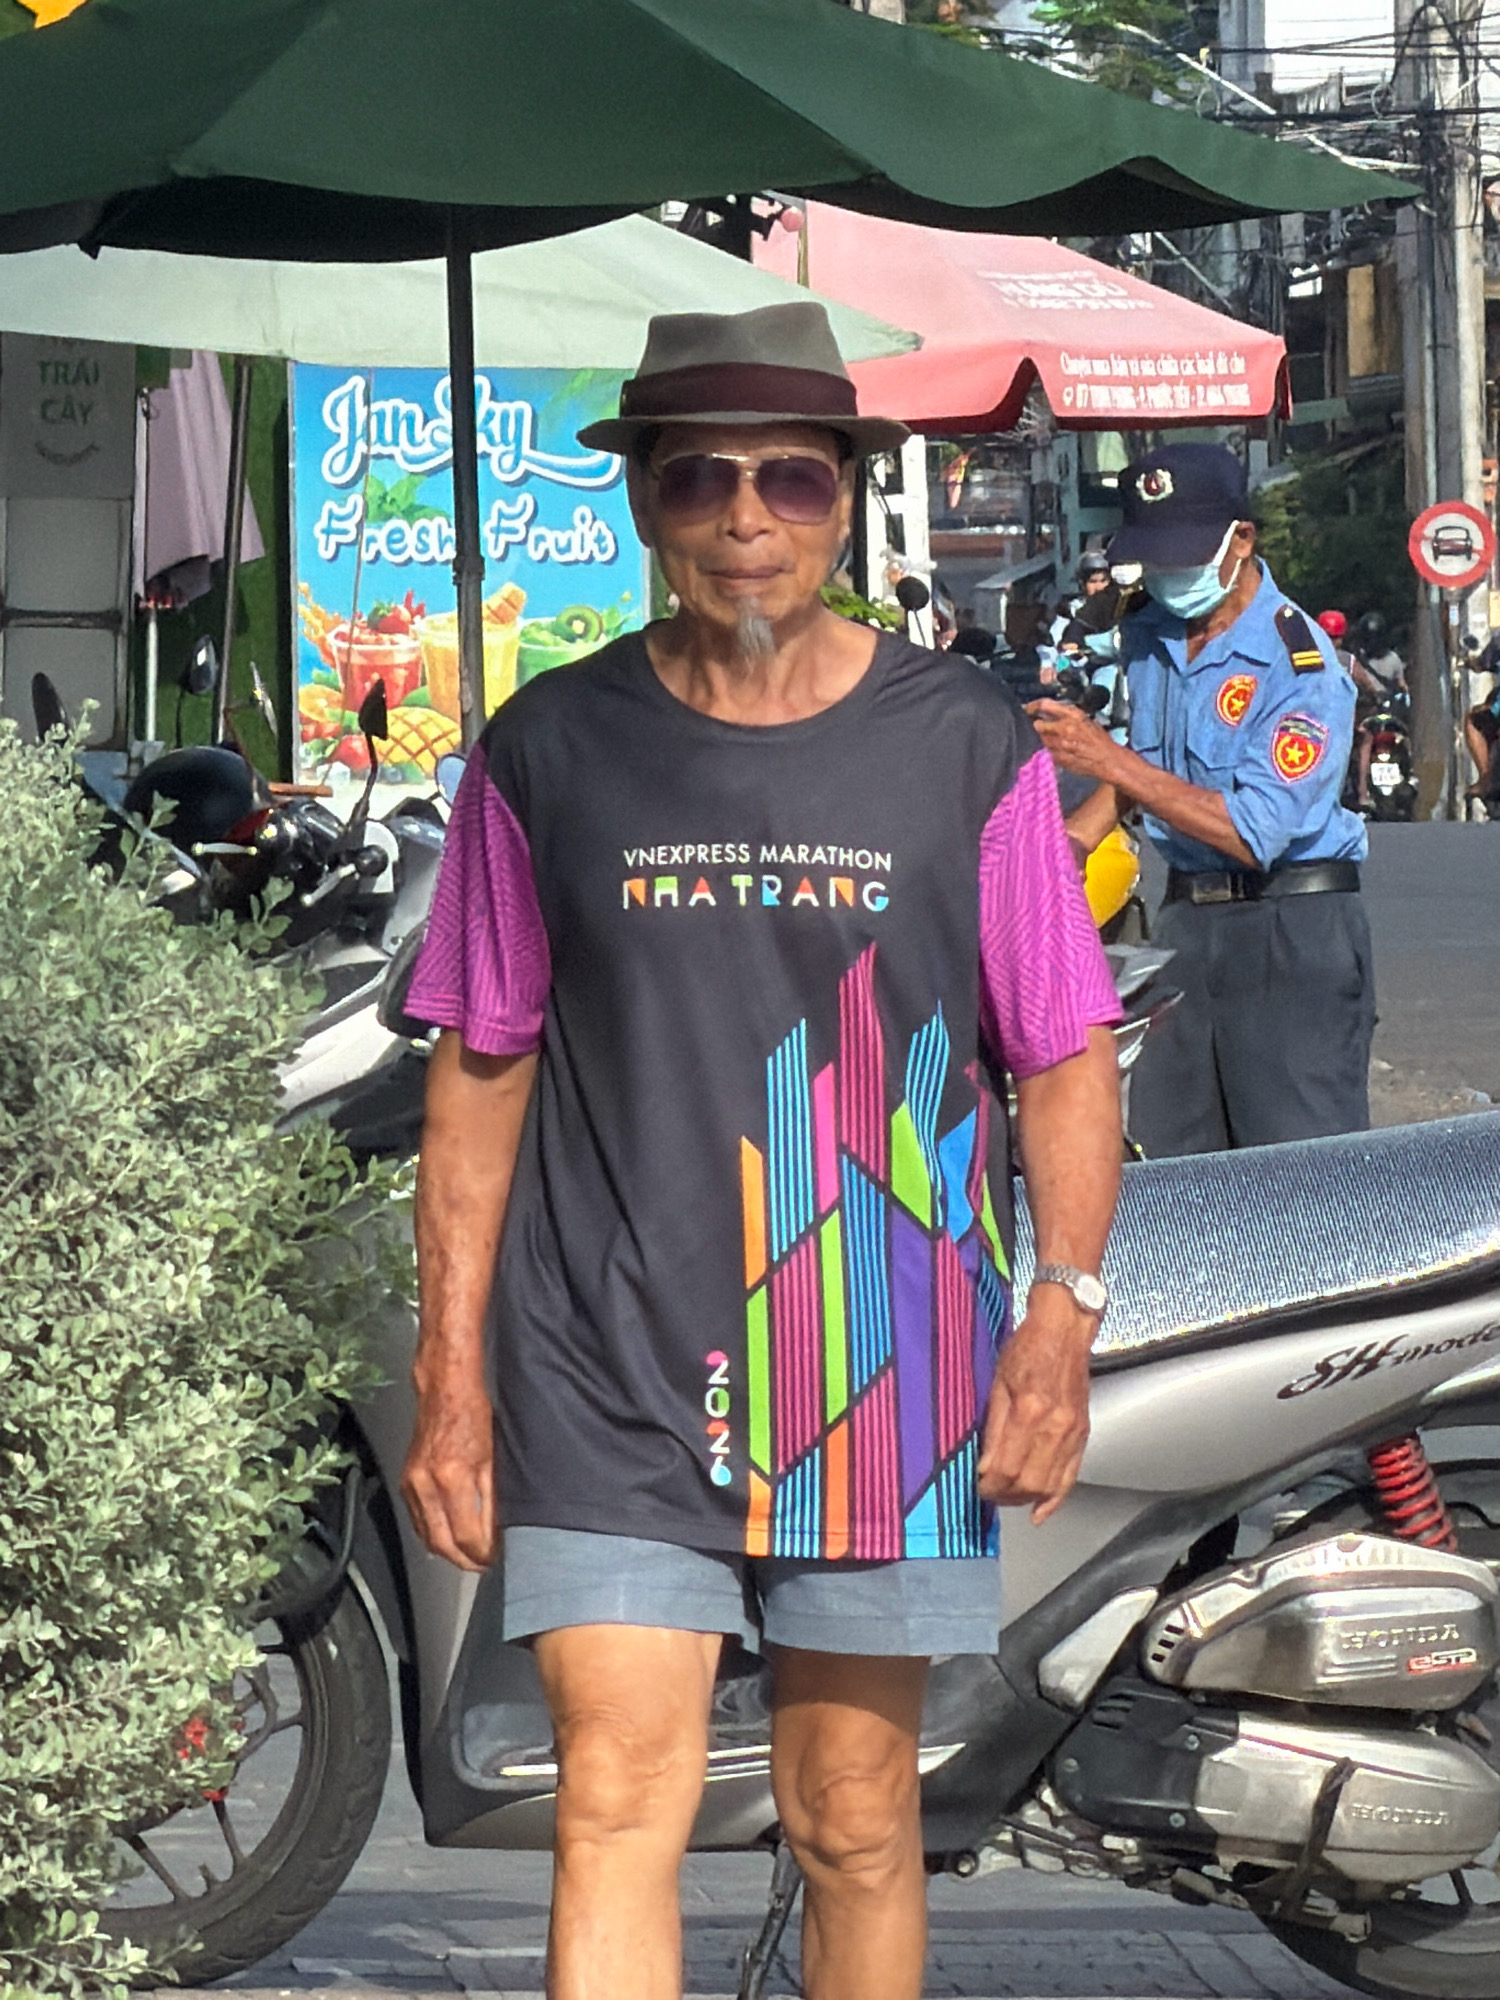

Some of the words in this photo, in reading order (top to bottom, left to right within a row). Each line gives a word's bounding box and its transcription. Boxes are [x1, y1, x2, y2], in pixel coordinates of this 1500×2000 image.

[483, 492, 615, 563] Fruit
[623, 843, 751, 868] VNEXPRESS
[759, 844, 892, 872] MARATHON
[622, 875, 717, 910] NHA
[731, 874, 889, 912] TRANG
[1277, 1333, 1409, 1400] SH
[1339, 1623, 1460, 1650] HONDA
